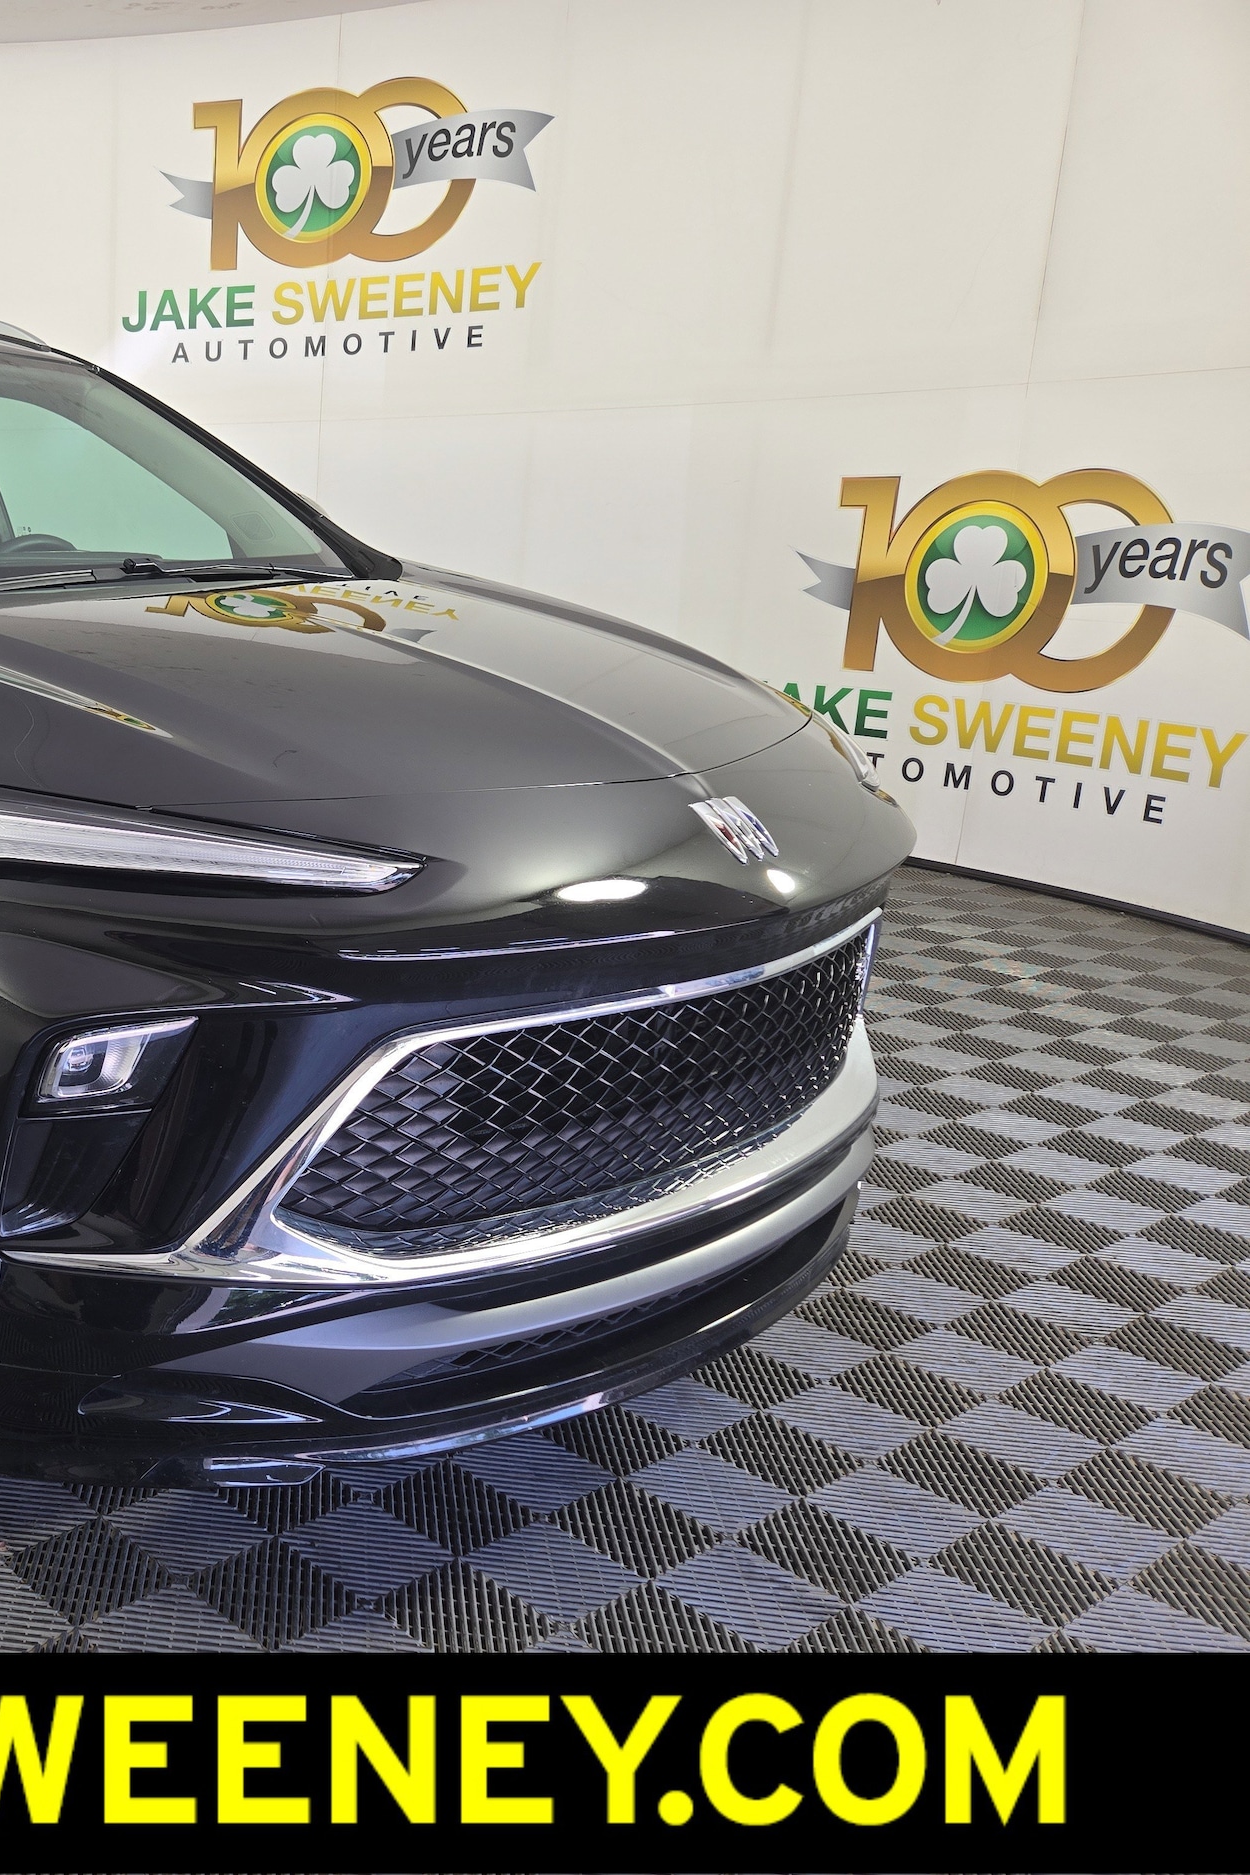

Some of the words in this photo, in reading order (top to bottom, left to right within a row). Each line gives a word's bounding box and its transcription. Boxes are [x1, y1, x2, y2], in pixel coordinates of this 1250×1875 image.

[402, 118, 517, 180] years
[122, 284, 256, 333] JAKE
[271, 261, 543, 326] SWEENEY
[171, 325, 485, 364] AUTOMOTIVE
[1083, 536, 1234, 596] years
[909, 694, 1248, 789] SWEENEY
[867, 751, 1168, 825] TOMOTIVE
